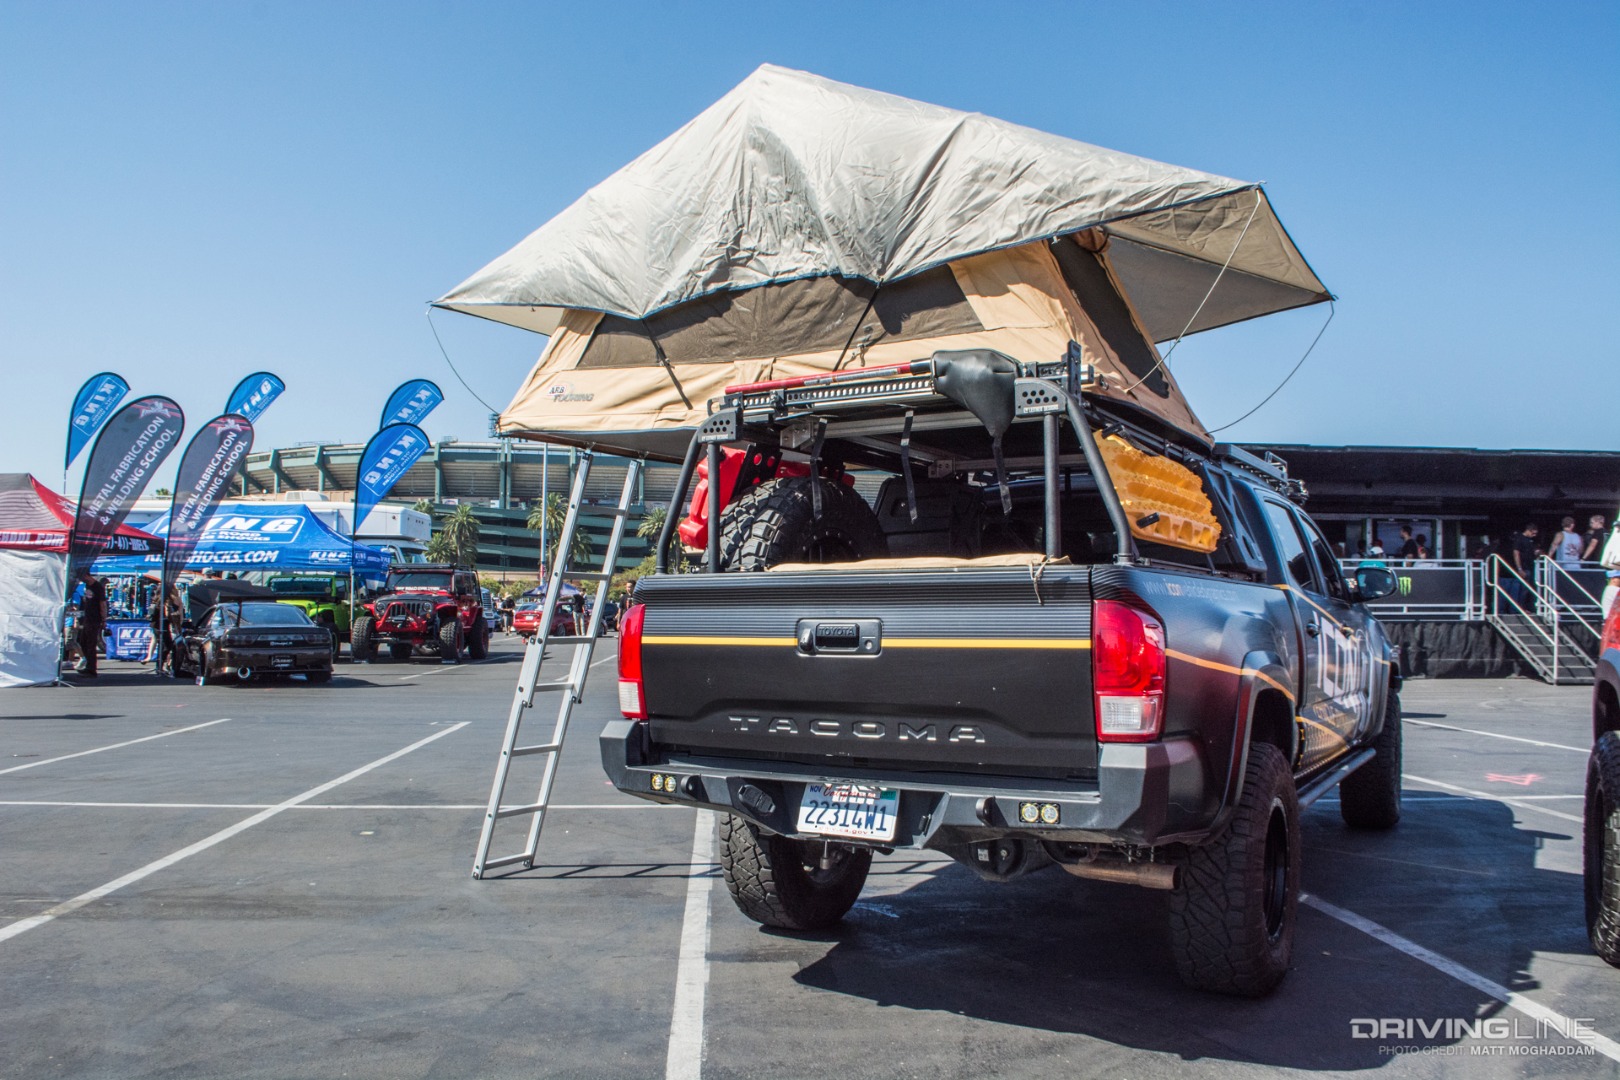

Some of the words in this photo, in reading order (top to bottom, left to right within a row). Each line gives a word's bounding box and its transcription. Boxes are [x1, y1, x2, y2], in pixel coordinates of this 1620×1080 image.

[553, 393, 595, 402] TOURING
[140, 428, 177, 469] SCHOOL
[219, 440, 248, 478] SCHOOL
[86, 483, 116, 518] METAL
[110, 416, 165, 483] FABRICATION
[177, 492, 200, 524] METAL
[194, 431, 237, 493] FABRICATION
[105, 467, 145, 516] WELDING
[191, 477, 224, 524] WELDING
[100, 515, 111, 526] &
[187, 520, 197, 530] &
[310, 551, 348, 559] KING
[819, 626, 855, 636] TOYOTA
[728, 716, 986, 743] TACOMA
[809, 785, 822, 793] NOV
[804, 800, 887, 832] 22314W1
